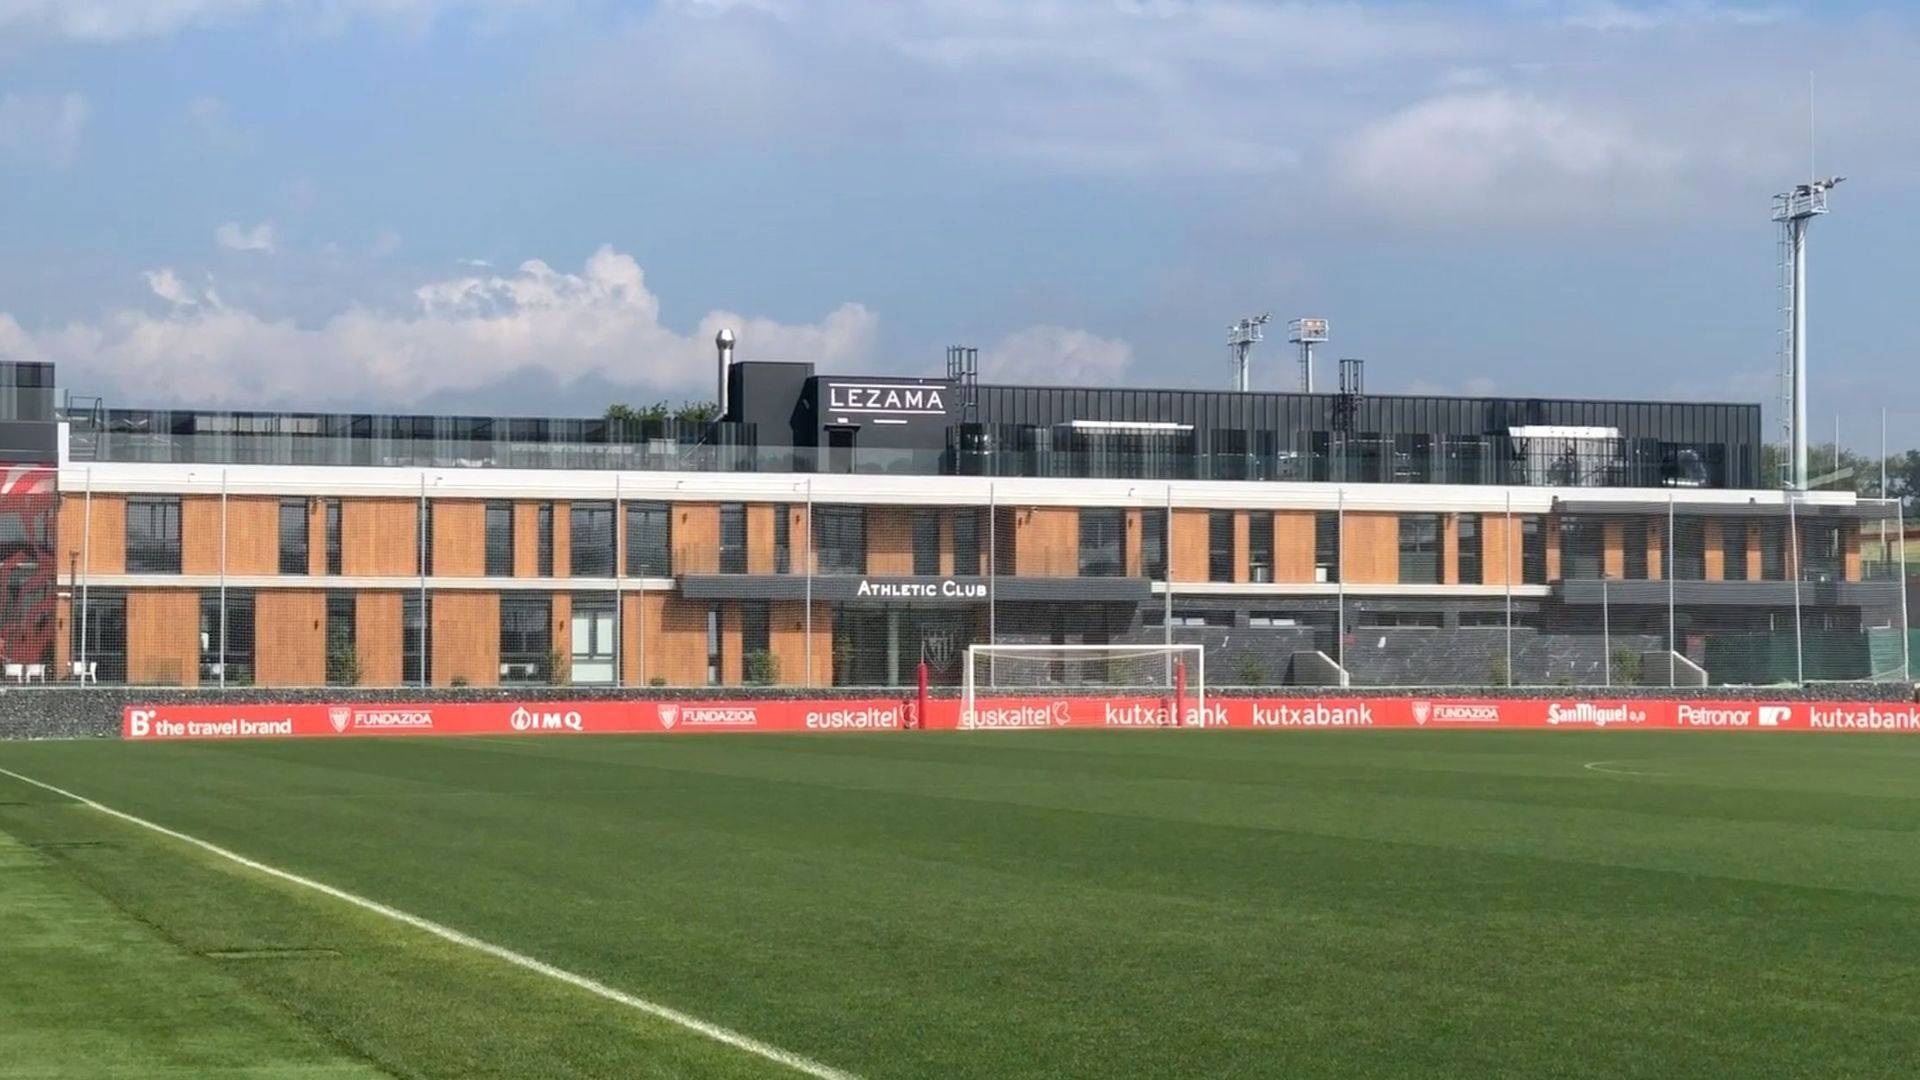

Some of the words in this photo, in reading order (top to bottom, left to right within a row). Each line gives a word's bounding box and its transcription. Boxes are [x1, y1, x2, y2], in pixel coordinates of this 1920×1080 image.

[831, 388, 944, 409] LEZAMA
[355, 713, 433, 725] FUNDAZIOA
[532, 711, 583, 731] IMQ
[682, 710, 757, 722] FUNDAZIOA
[806, 707, 898, 728] euskaltel
[962, 705, 1051, 726] euskaltel
[1252, 702, 1373, 725] kutxabank
[1433, 707, 1499, 719] FUNDAZIOA
[1678, 705, 1751, 725] Petronor
[1810, 706, 1920, 728] kutxabank
[155, 719, 184, 736] the
[188, 718, 237, 736] travel
[240, 718, 292, 735] brand
